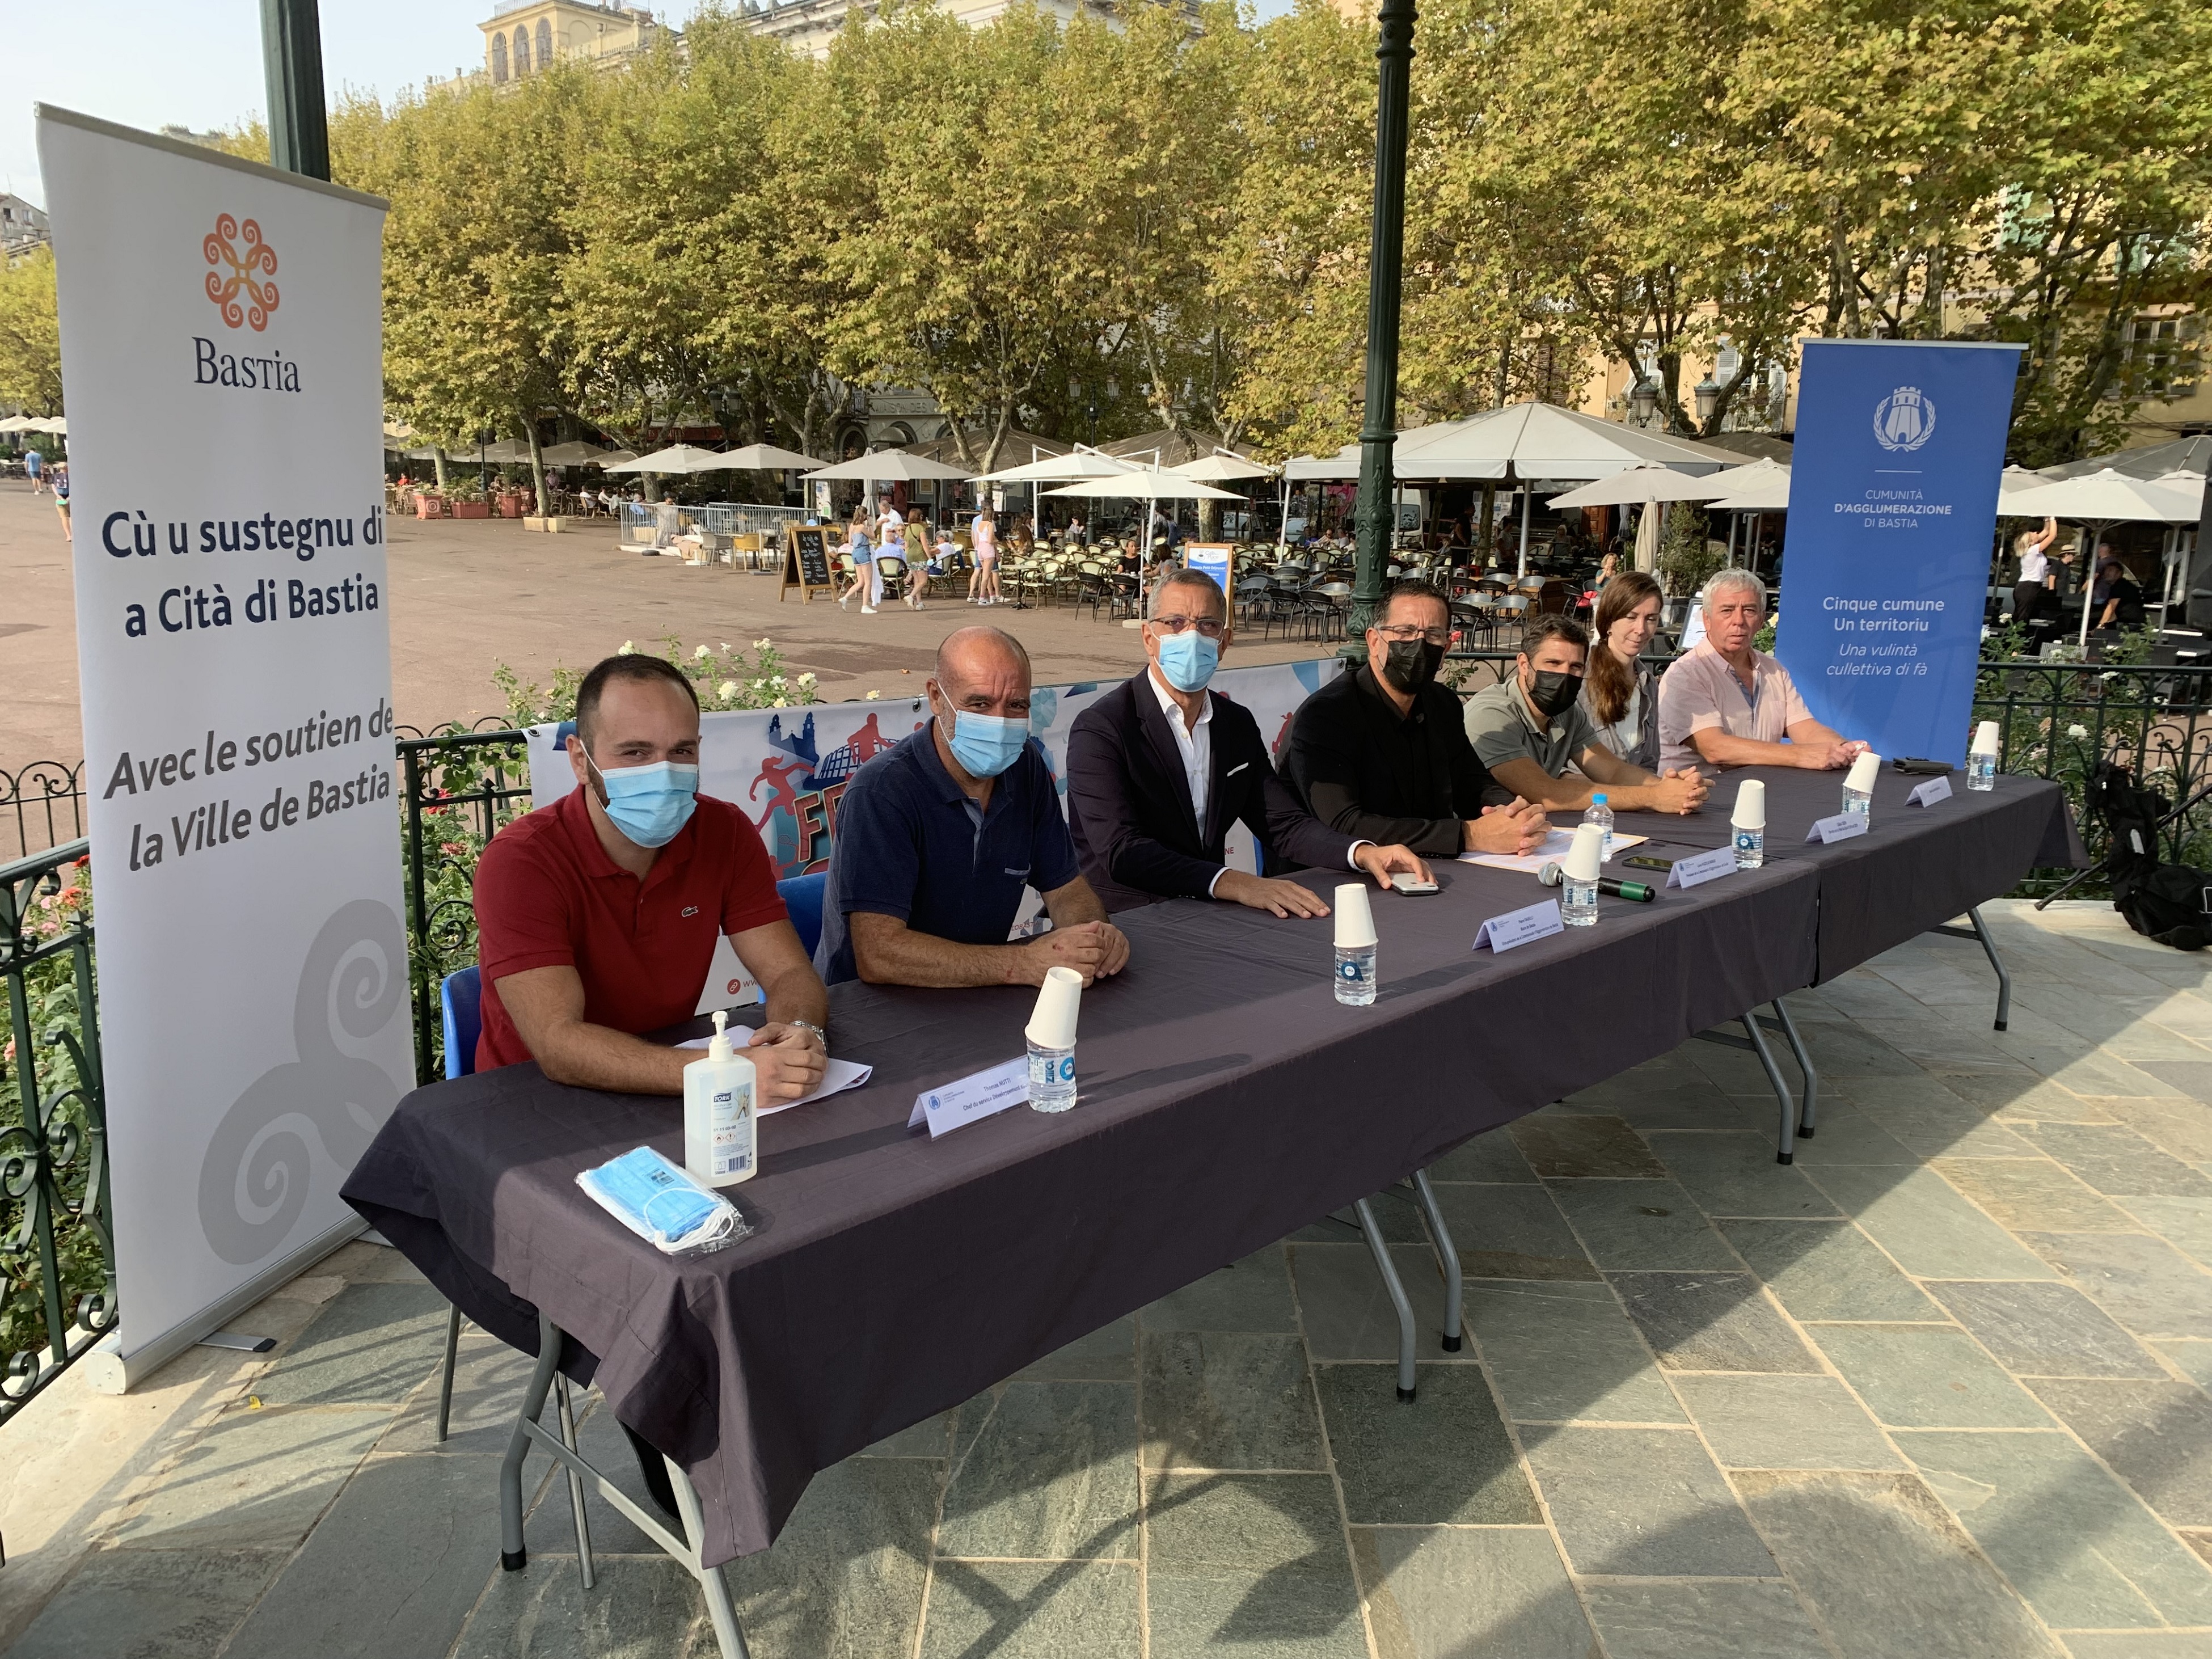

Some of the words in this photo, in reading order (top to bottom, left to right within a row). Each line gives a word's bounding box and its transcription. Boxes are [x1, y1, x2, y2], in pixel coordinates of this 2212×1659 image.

[191, 336, 302, 392] Bastia
[1865, 488, 1923, 500] CUMUNITÀ
[1834, 503, 1952, 515] D'AGGLUMERAZIONE
[1864, 518, 1875, 527] DI
[1878, 518, 1918, 528] BASTIA
[102, 510, 157, 558] Cù
[168, 522, 188, 554] u
[200, 512, 354, 562] sustegnu
[364, 505, 383, 545] di
[125, 602, 147, 638] a
[158, 584, 233, 632] Cità
[245, 579, 277, 623] di
[288, 572, 379, 619] Bastia
[1823, 596, 1878, 613] Cinque
[1882, 599, 1945, 611] cumune
[1834, 617, 1855, 631] Un
[1860, 617, 1929, 632] territoriu
[1839, 643, 1867, 656] Una
[1872, 643, 1918, 656] vulintà
[1827, 662, 1892, 676] cullettiva
[1896, 662, 1910, 676] di
[1913, 662, 1927, 676] fà
[103, 747, 196, 800] Avec
[204, 731, 237, 776] le
[245, 710, 362, 767] soutien
[369, 697, 393, 737] de
[129, 824, 163, 872] la
[171, 799, 251, 856] Ville
[260, 787, 299, 832] de
[306, 763, 390, 820] Bastia
